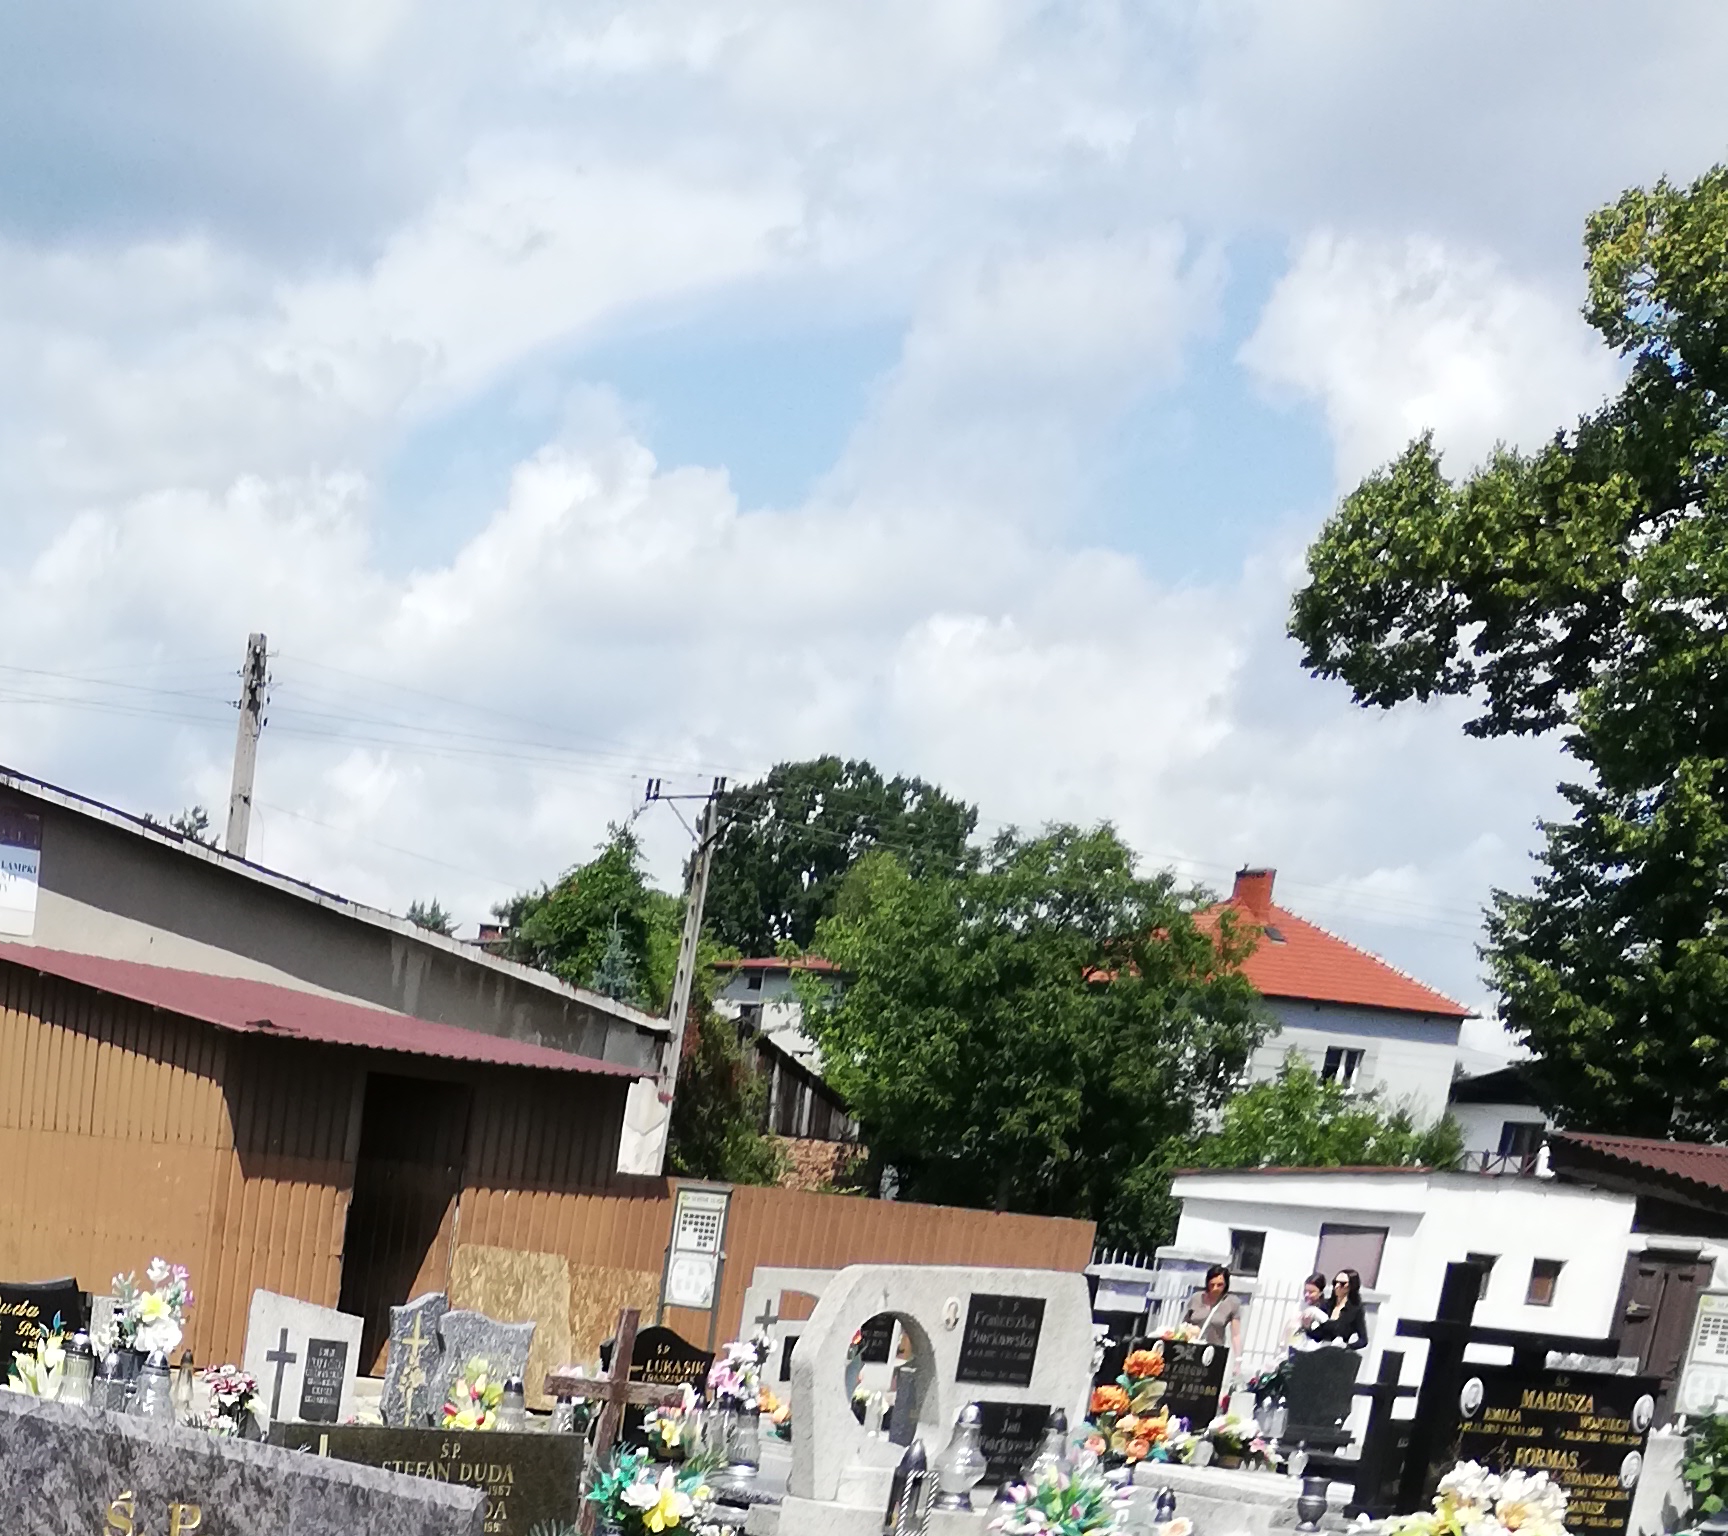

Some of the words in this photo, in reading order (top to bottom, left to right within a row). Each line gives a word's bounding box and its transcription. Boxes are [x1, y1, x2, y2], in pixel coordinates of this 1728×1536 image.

[1, 860, 38, 875] LAMPKI
[1520, 1389, 1595, 1414] MARUSZA
[1513, 1447, 1580, 1471] FORMAS
[381, 1460, 451, 1483] STEFAN
[459, 1462, 515, 1484] DUDA
